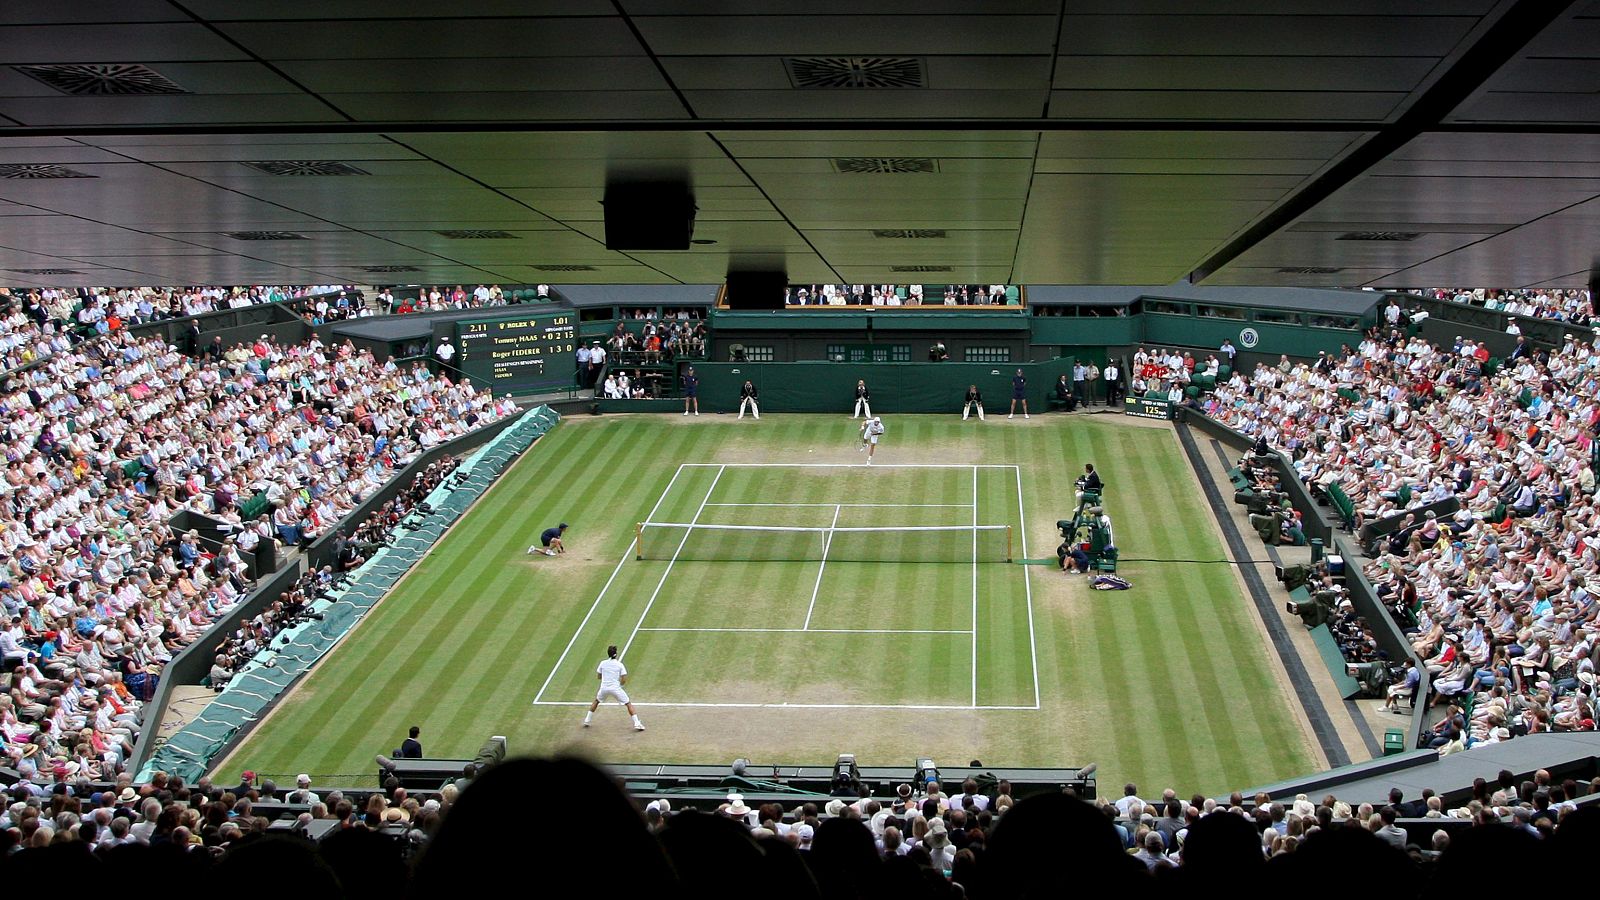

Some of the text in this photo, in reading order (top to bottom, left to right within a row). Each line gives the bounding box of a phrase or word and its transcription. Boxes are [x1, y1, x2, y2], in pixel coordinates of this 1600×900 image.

[470, 324, 487, 332] 2.11
[512, 348, 540, 356] FEDERER
[1145, 406, 1158, 414] 125
